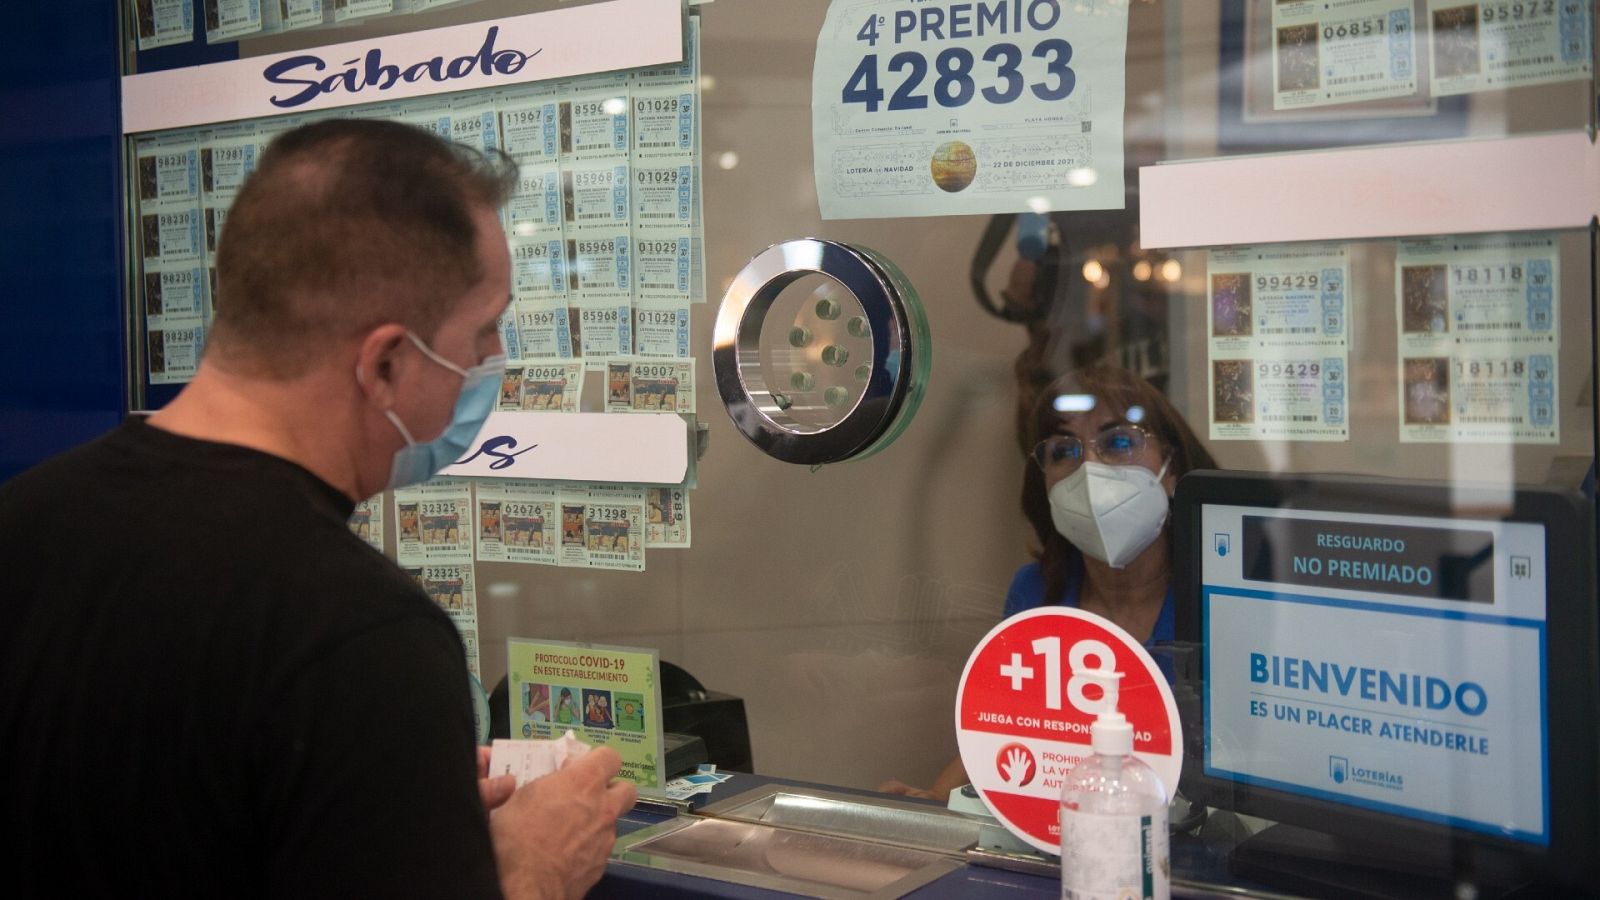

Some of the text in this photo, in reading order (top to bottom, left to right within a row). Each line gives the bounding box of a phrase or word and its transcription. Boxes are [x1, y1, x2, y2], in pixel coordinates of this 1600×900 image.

[1483, 0, 1554, 22] 95972
[894, 0, 1061, 44] PREMIO
[1323, 19, 1384, 39] 06851
[263, 26, 542, 108] Sábado
[841, 38, 1076, 113] 42833
[575, 103, 606, 115] 8596
[637, 99, 678, 112] 01029
[507, 110, 541, 123] 11967
[158, 155, 187, 168] 98230
[1015, 159, 1055, 167] DICIEMBRE
[883, 165, 914, 173] NAVIDAD
[575, 171, 612, 184] 85968
[638, 171, 677, 182] 01029
[160, 214, 190, 226] 98230
[579, 241, 615, 253] 85968
[638, 242, 677, 253] 01029
[1455, 267, 1522, 281] 18118
[1257, 275, 1319, 290] 99429
[520, 312, 555, 324] 11967
[583, 310, 617, 321] 85968
[639, 312, 676, 323] 01029
[527, 367, 566, 378] 80604
[635, 366, 675, 377] 49007
[1259, 363, 1320, 376] 99429
[422, 502, 456, 514] 32325
[505, 503, 542, 515] 62676
[588, 507, 627, 519] 31298
[673, 491, 684, 522] 689
[1316, 533, 1405, 553] RESGUARDO
[427, 568, 460, 578] 32325
[1293, 556, 1432, 585] NO PREMIADO
[535, 653, 625, 670] PROTOCOLO COVID-19
[533, 665, 629, 683] EN ESTE ESTABLECIMIENTO
[1000, 636, 1119, 715] +18
[1250, 652, 1488, 717] BIENVENIDO
[977, 711, 1152, 742] JUEGA CON RESPONSAD
[1250, 700, 1489, 755] ES UN PLACER ATENDERLE
[1042, 766, 1056, 775] LA
